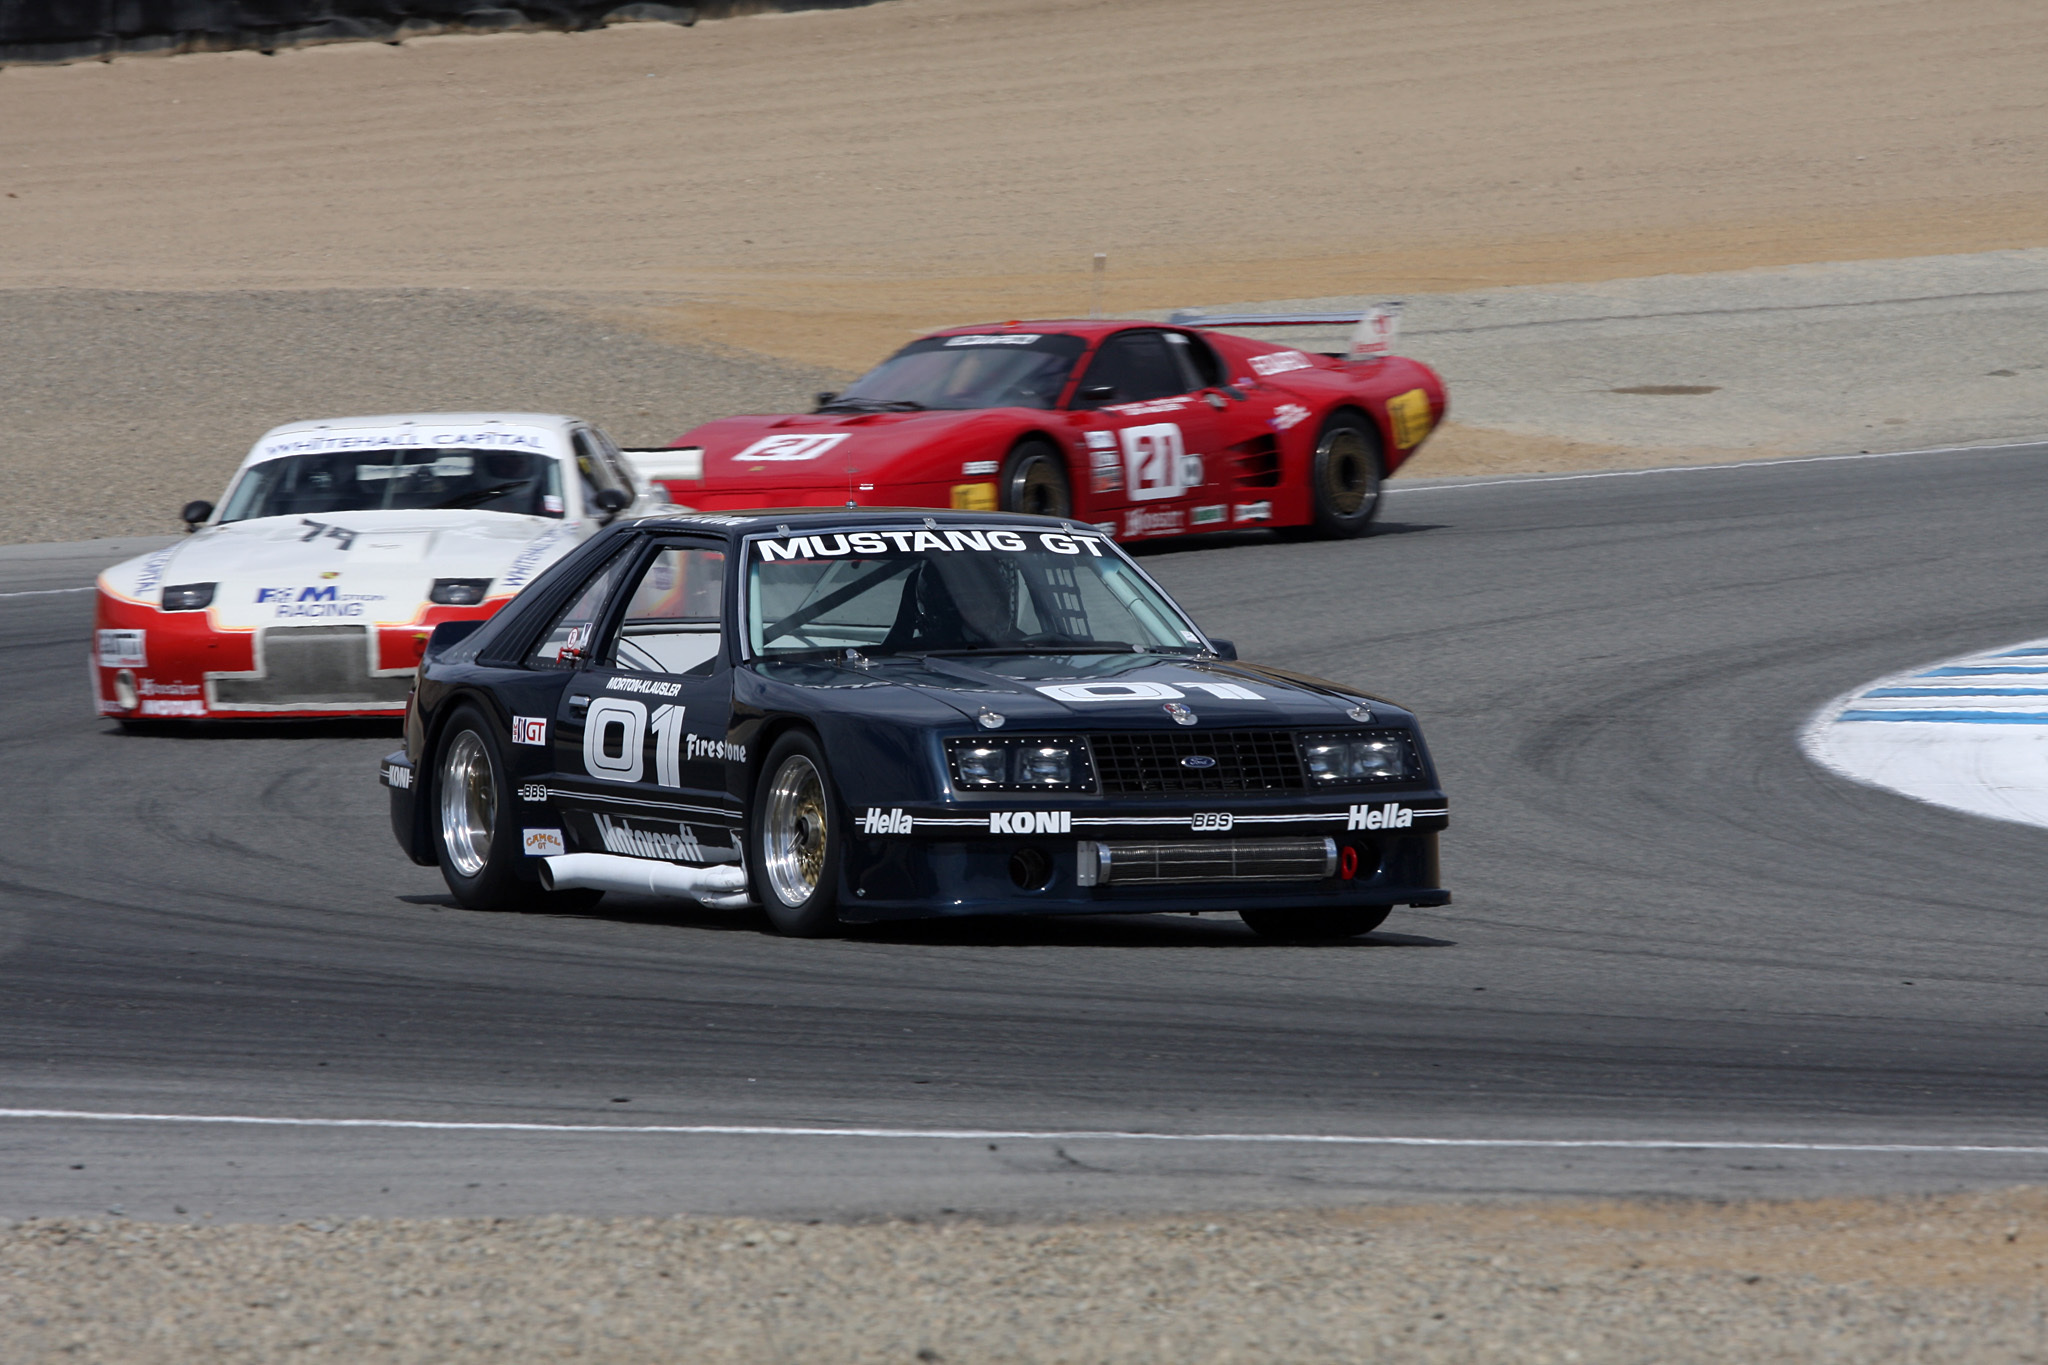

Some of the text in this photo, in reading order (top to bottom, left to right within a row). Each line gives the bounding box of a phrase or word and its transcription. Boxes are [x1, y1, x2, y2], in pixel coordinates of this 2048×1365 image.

[431, 432, 546, 449] CAPITAL
[1135, 434, 1174, 490] 21
[300, 518, 357, 551] 79
[757, 531, 1103, 562] MUSTANG GT
[275, 602, 364, 618] RACING
[606, 676, 682, 697] MORTON-KLAUSLER
[1035, 682, 1267, 701] 01
[526, 721, 545, 741] GT
[583, 697, 686, 788] 01
[686, 733, 747, 763] Firestone
[389, 765, 410, 789] KONI
[523, 784, 547, 801] BBS
[864, 807, 914, 834] Hella
[990, 811, 1072, 833] KONI
[1191, 813, 1234, 831] BBS
[1347, 803, 1413, 831] Hella
[526, 833, 561, 847] CAMEL
[592, 812, 705, 862] Motorcraft
